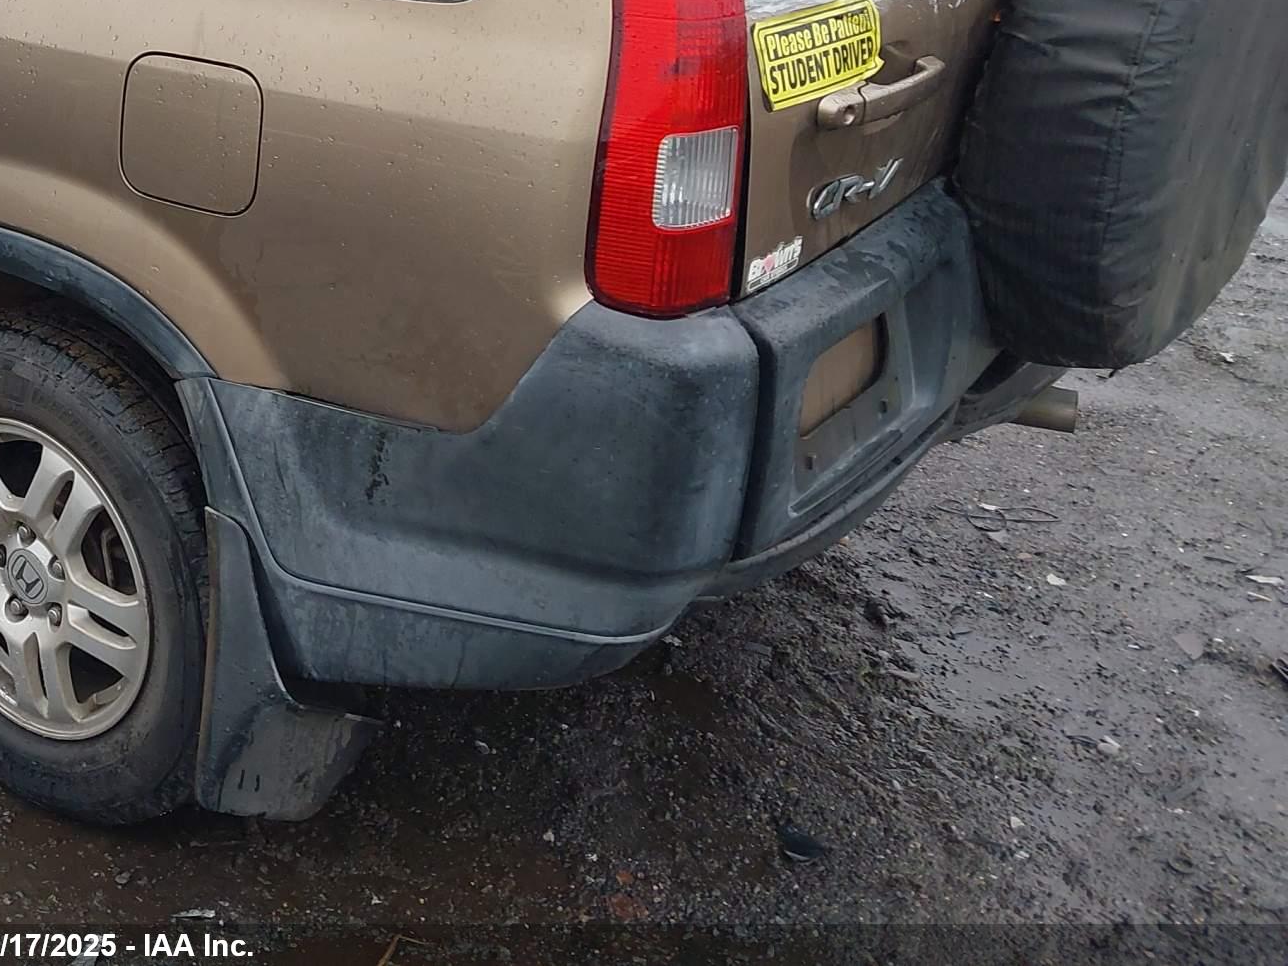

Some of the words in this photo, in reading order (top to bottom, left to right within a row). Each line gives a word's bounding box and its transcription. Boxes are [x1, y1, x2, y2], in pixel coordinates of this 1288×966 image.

[766, 28, 812, 60] Please
[813, 21, 830, 46] Be
[830, 9, 872, 41] Patient
[769, 49, 832, 95] STUDENT
[833, 35, 874, 76] DRIVER
[806, 157, 903, 220] CR-V
